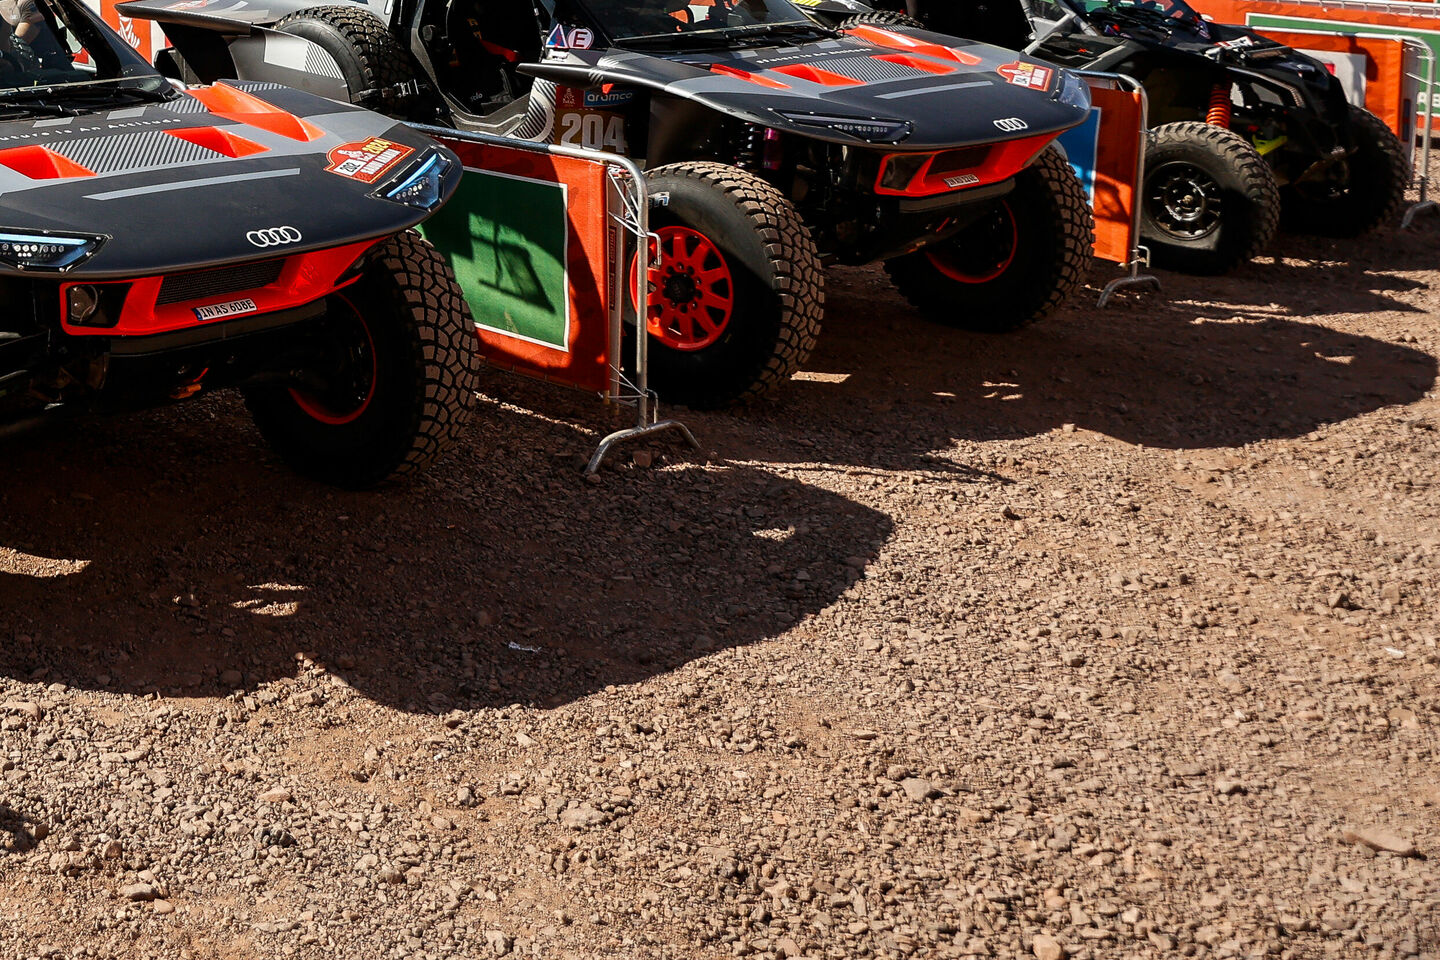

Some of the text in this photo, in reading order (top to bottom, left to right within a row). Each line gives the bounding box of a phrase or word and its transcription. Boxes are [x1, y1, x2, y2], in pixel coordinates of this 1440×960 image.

[573, 31, 588, 48] E
[586, 91, 633, 102] aramco
[561, 112, 627, 154] 204
[215, 304, 229, 316] AS
